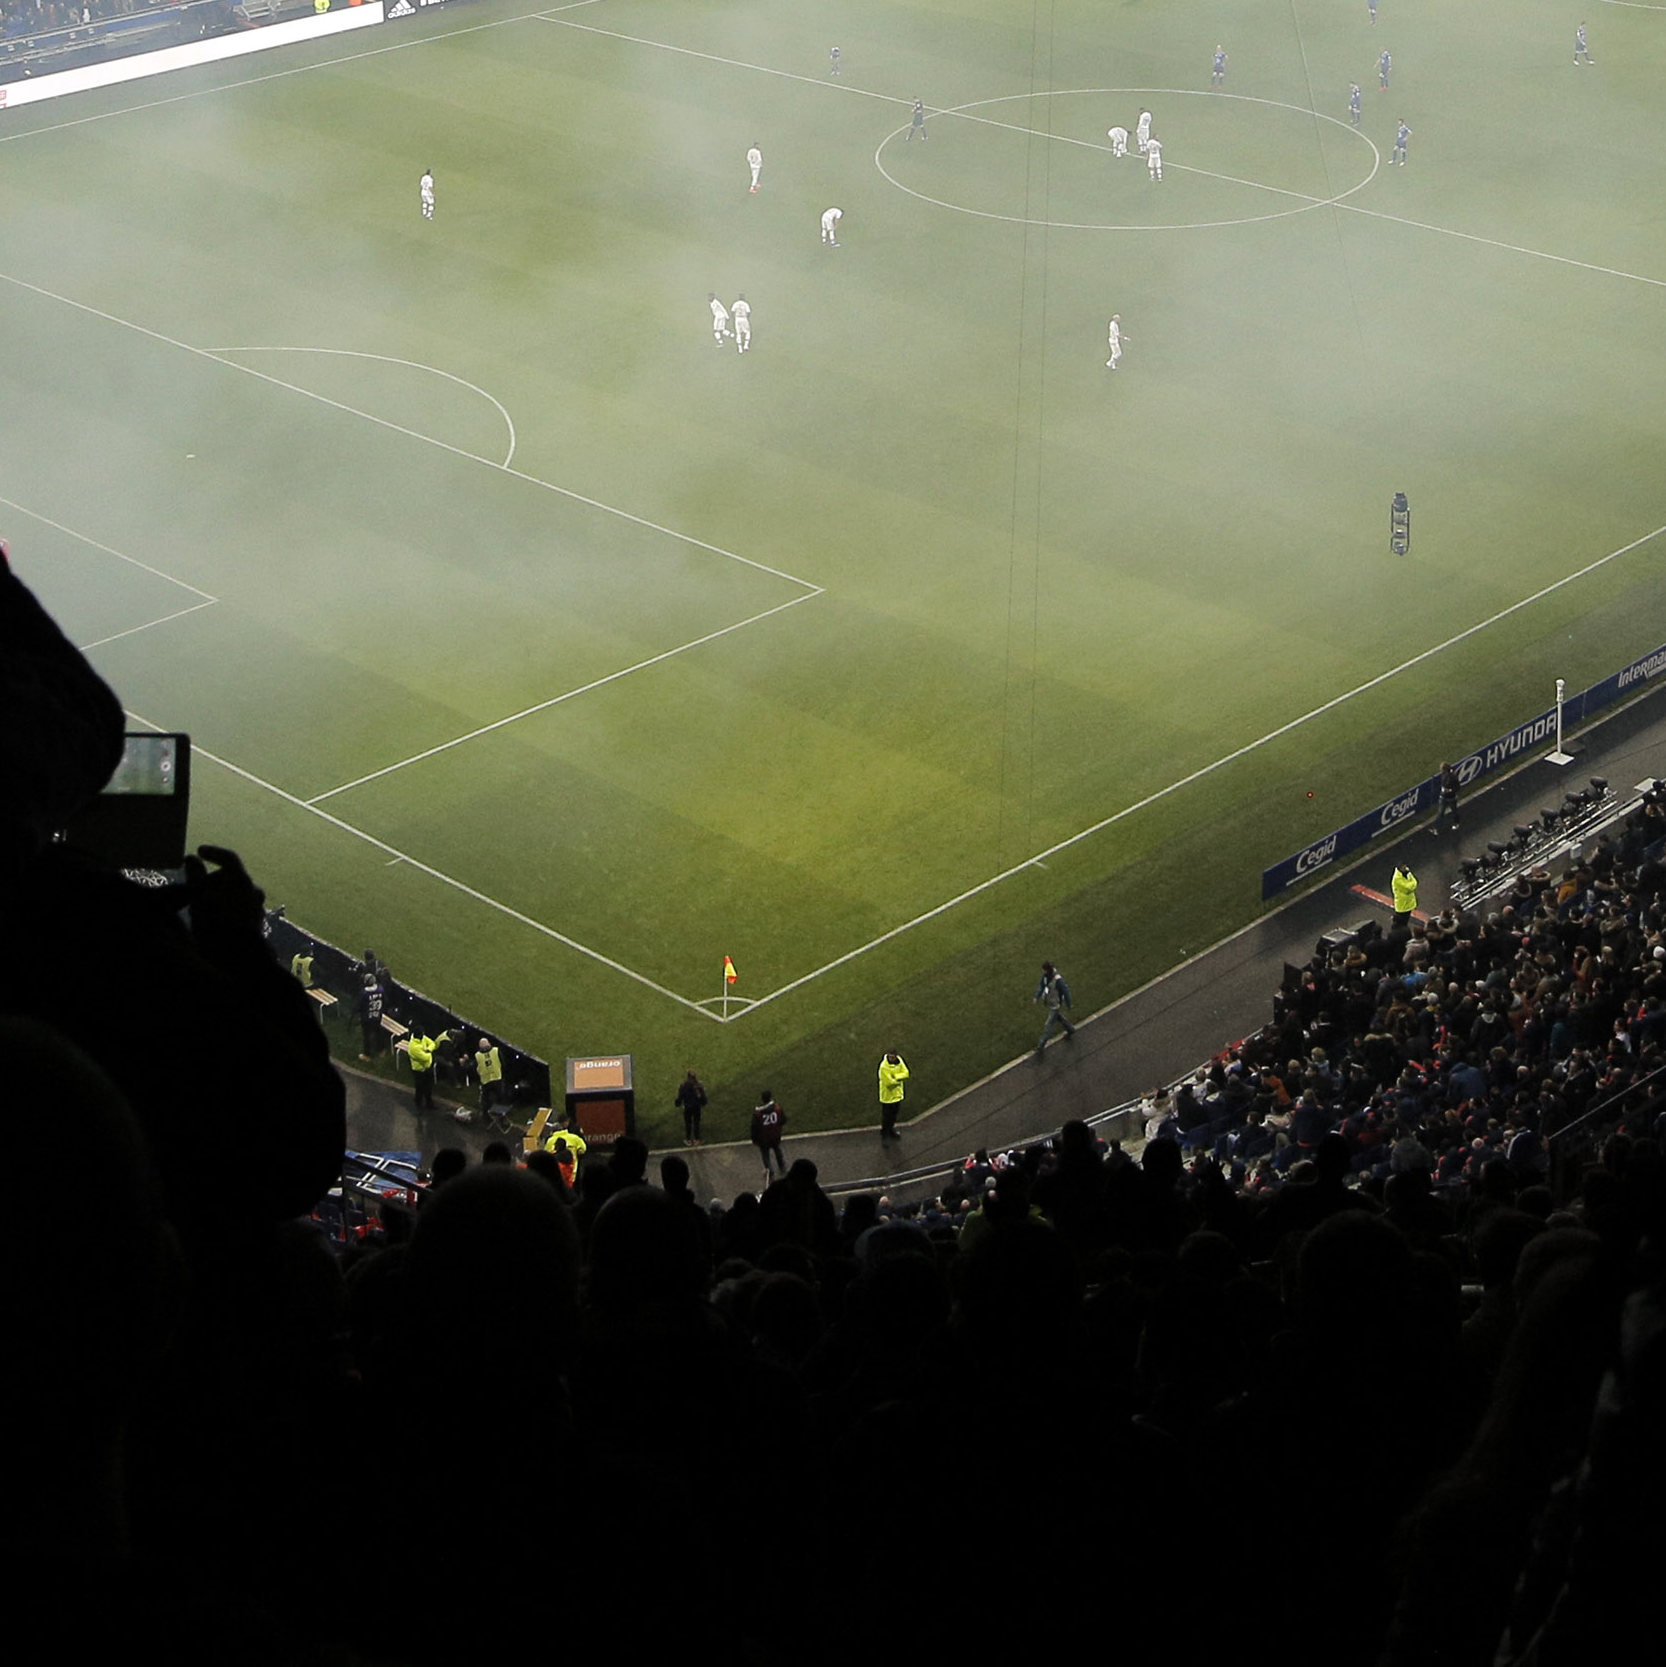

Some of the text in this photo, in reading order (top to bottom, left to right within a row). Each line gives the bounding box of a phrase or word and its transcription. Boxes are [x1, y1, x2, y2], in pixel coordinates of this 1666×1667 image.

[1486, 711, 1557, 769] HYUNDA
[1381, 788, 1419, 825] Cegid
[1295, 835, 1337, 874] Cegid
[579, 1060, 622, 1070] orange
[762, 1111, 778, 1126] 20
[584, 1132, 622, 1143] range
